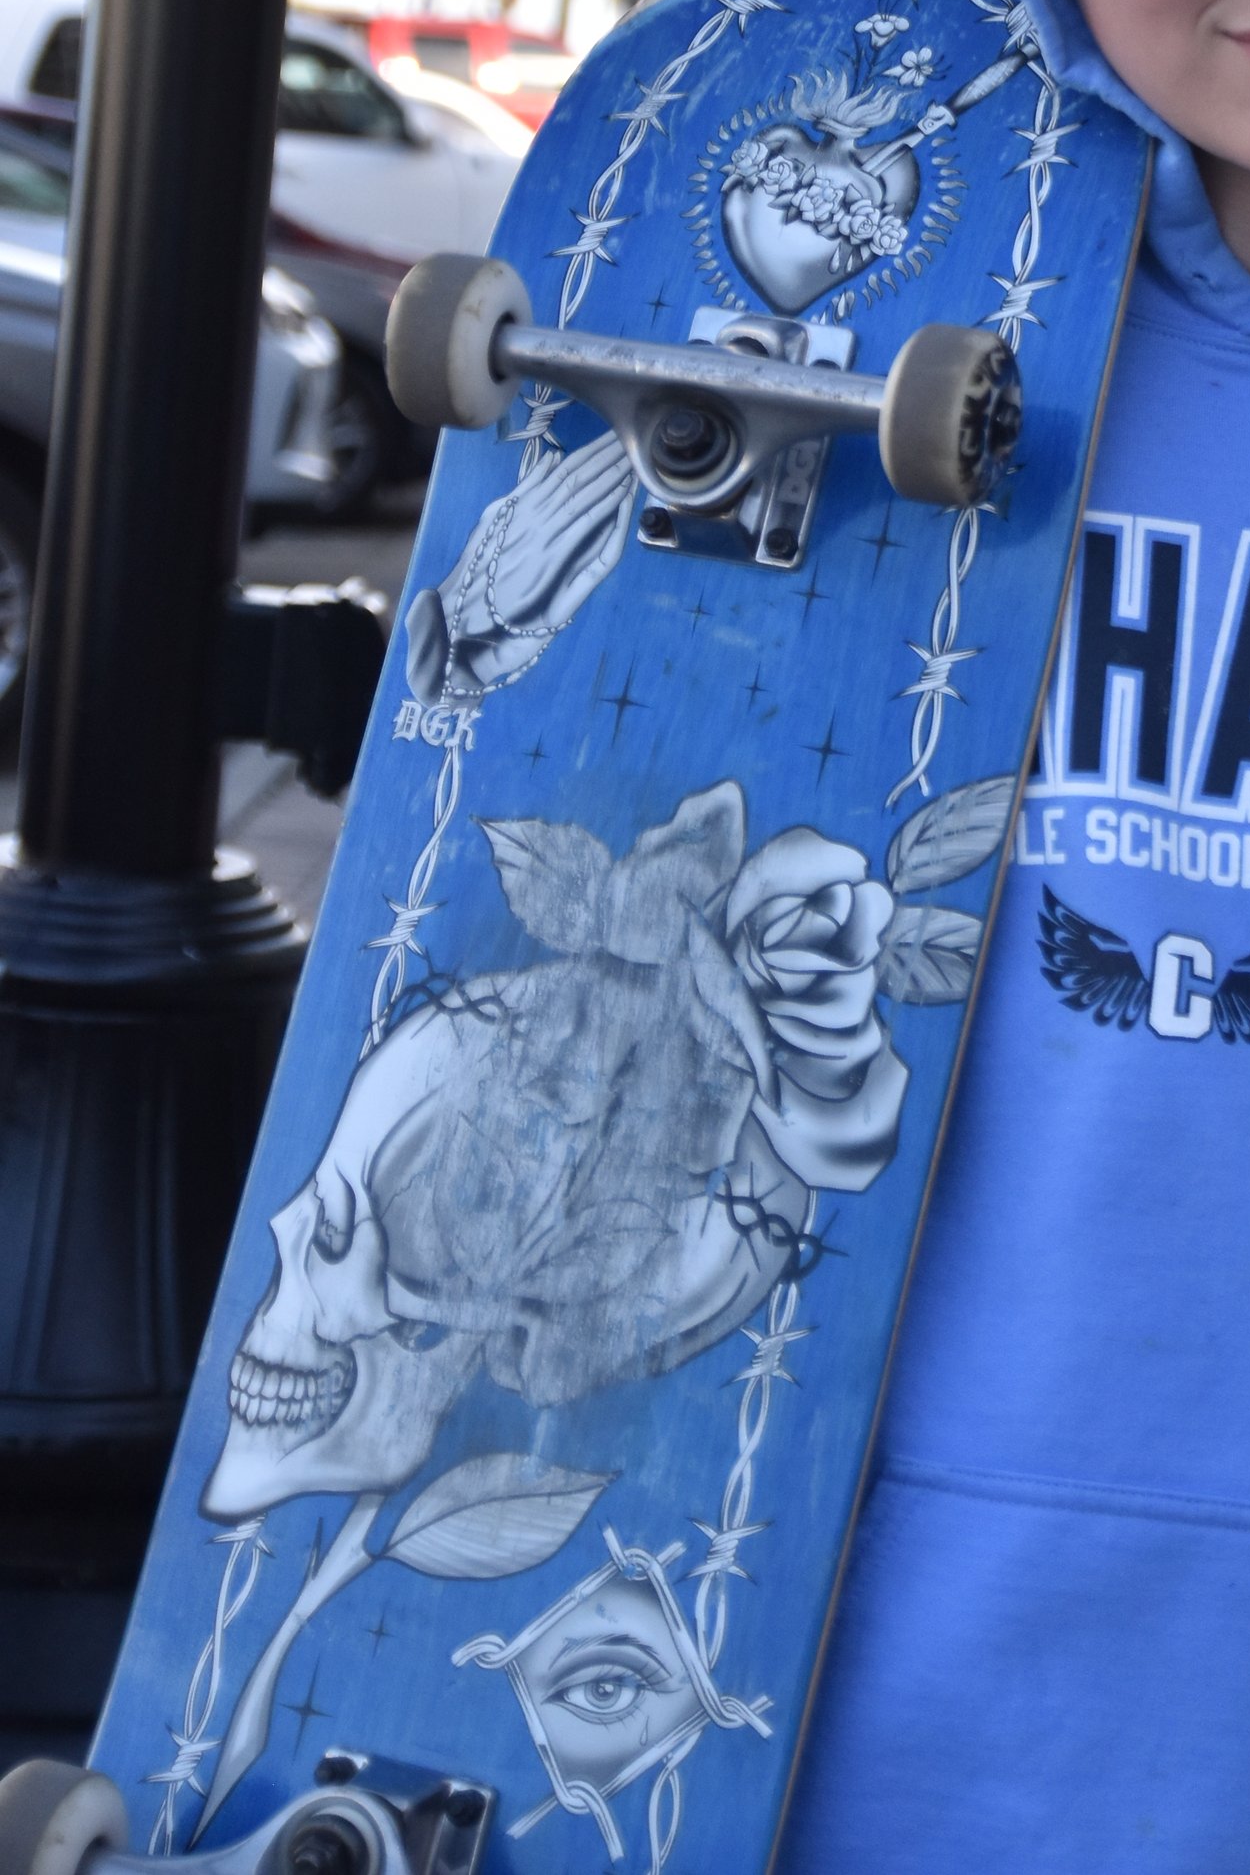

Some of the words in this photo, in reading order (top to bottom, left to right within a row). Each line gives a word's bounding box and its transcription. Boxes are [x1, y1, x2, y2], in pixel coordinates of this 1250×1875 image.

[391, 699, 482, 752] DGK
[1008, 809, 1067, 866] LE
[1149, 932, 1215, 1041] C
